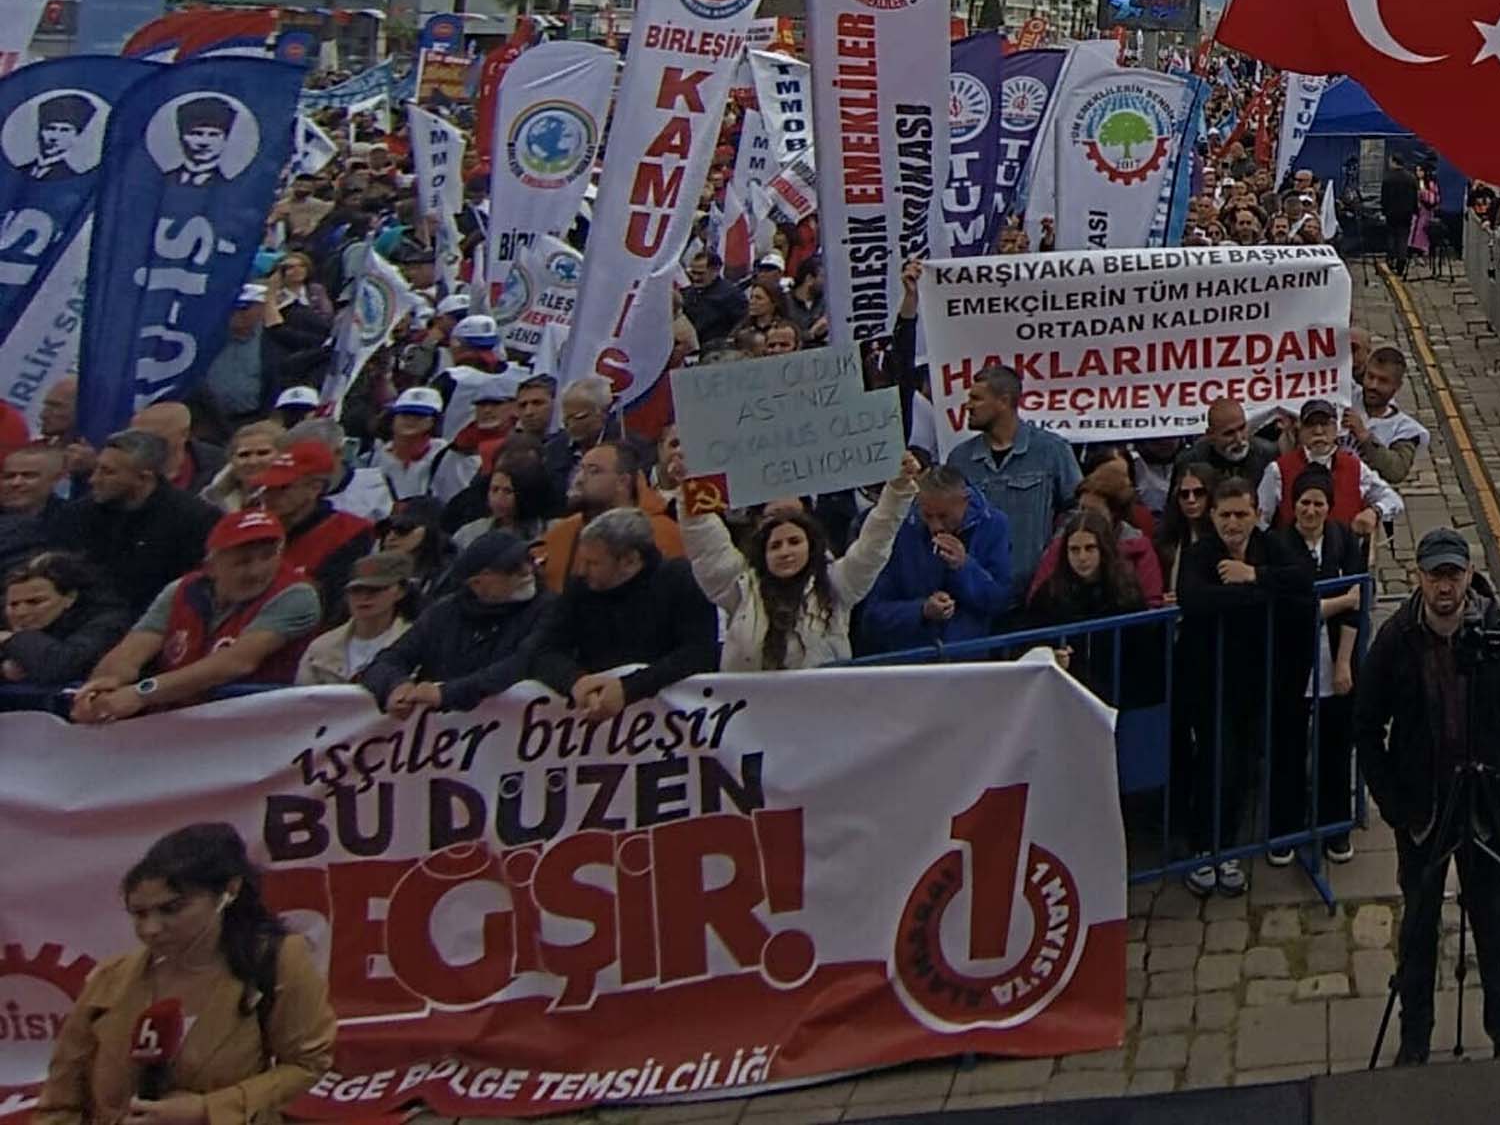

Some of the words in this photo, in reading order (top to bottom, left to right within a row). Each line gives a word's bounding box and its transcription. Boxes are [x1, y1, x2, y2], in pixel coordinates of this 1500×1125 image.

[644, 20, 745, 62] BİRLEŞİK
[771, 64, 807, 151] TMMOB
[832, 13, 885, 205] EMEKLİLER
[624, 67, 713, 258] KAMU
[894, 104, 933, 265] ENDİKASI
[941, 152, 985, 247] TÜM
[841, 215, 893, 342] BİRLEŞİK
[936, 254, 1094, 285] KARŞIYAKA
[1103, 248, 1222, 275] BELEDİYE
[1228, 247, 1335, 266] BAŞKANI
[946, 288, 1127, 317] EMEKÇİLERİN
[1133, 284, 1189, 305] TÜM
[1196, 268, 1330, 298] HAKLARINI
[1016, 316, 1144, 341] ORTADAN
[1152, 302, 1270, 329] KALDIRDI
[1018, 367, 1339, 415] GEÇMEYECEĞİZ!!!
[292, 707, 500, 797] işçiler
[517, 687, 748, 764] birleşir
[262, 782, 395, 861] BU
[428, 752, 766, 851] DÜZEN
[308, 1068, 399, 1103] EGE
